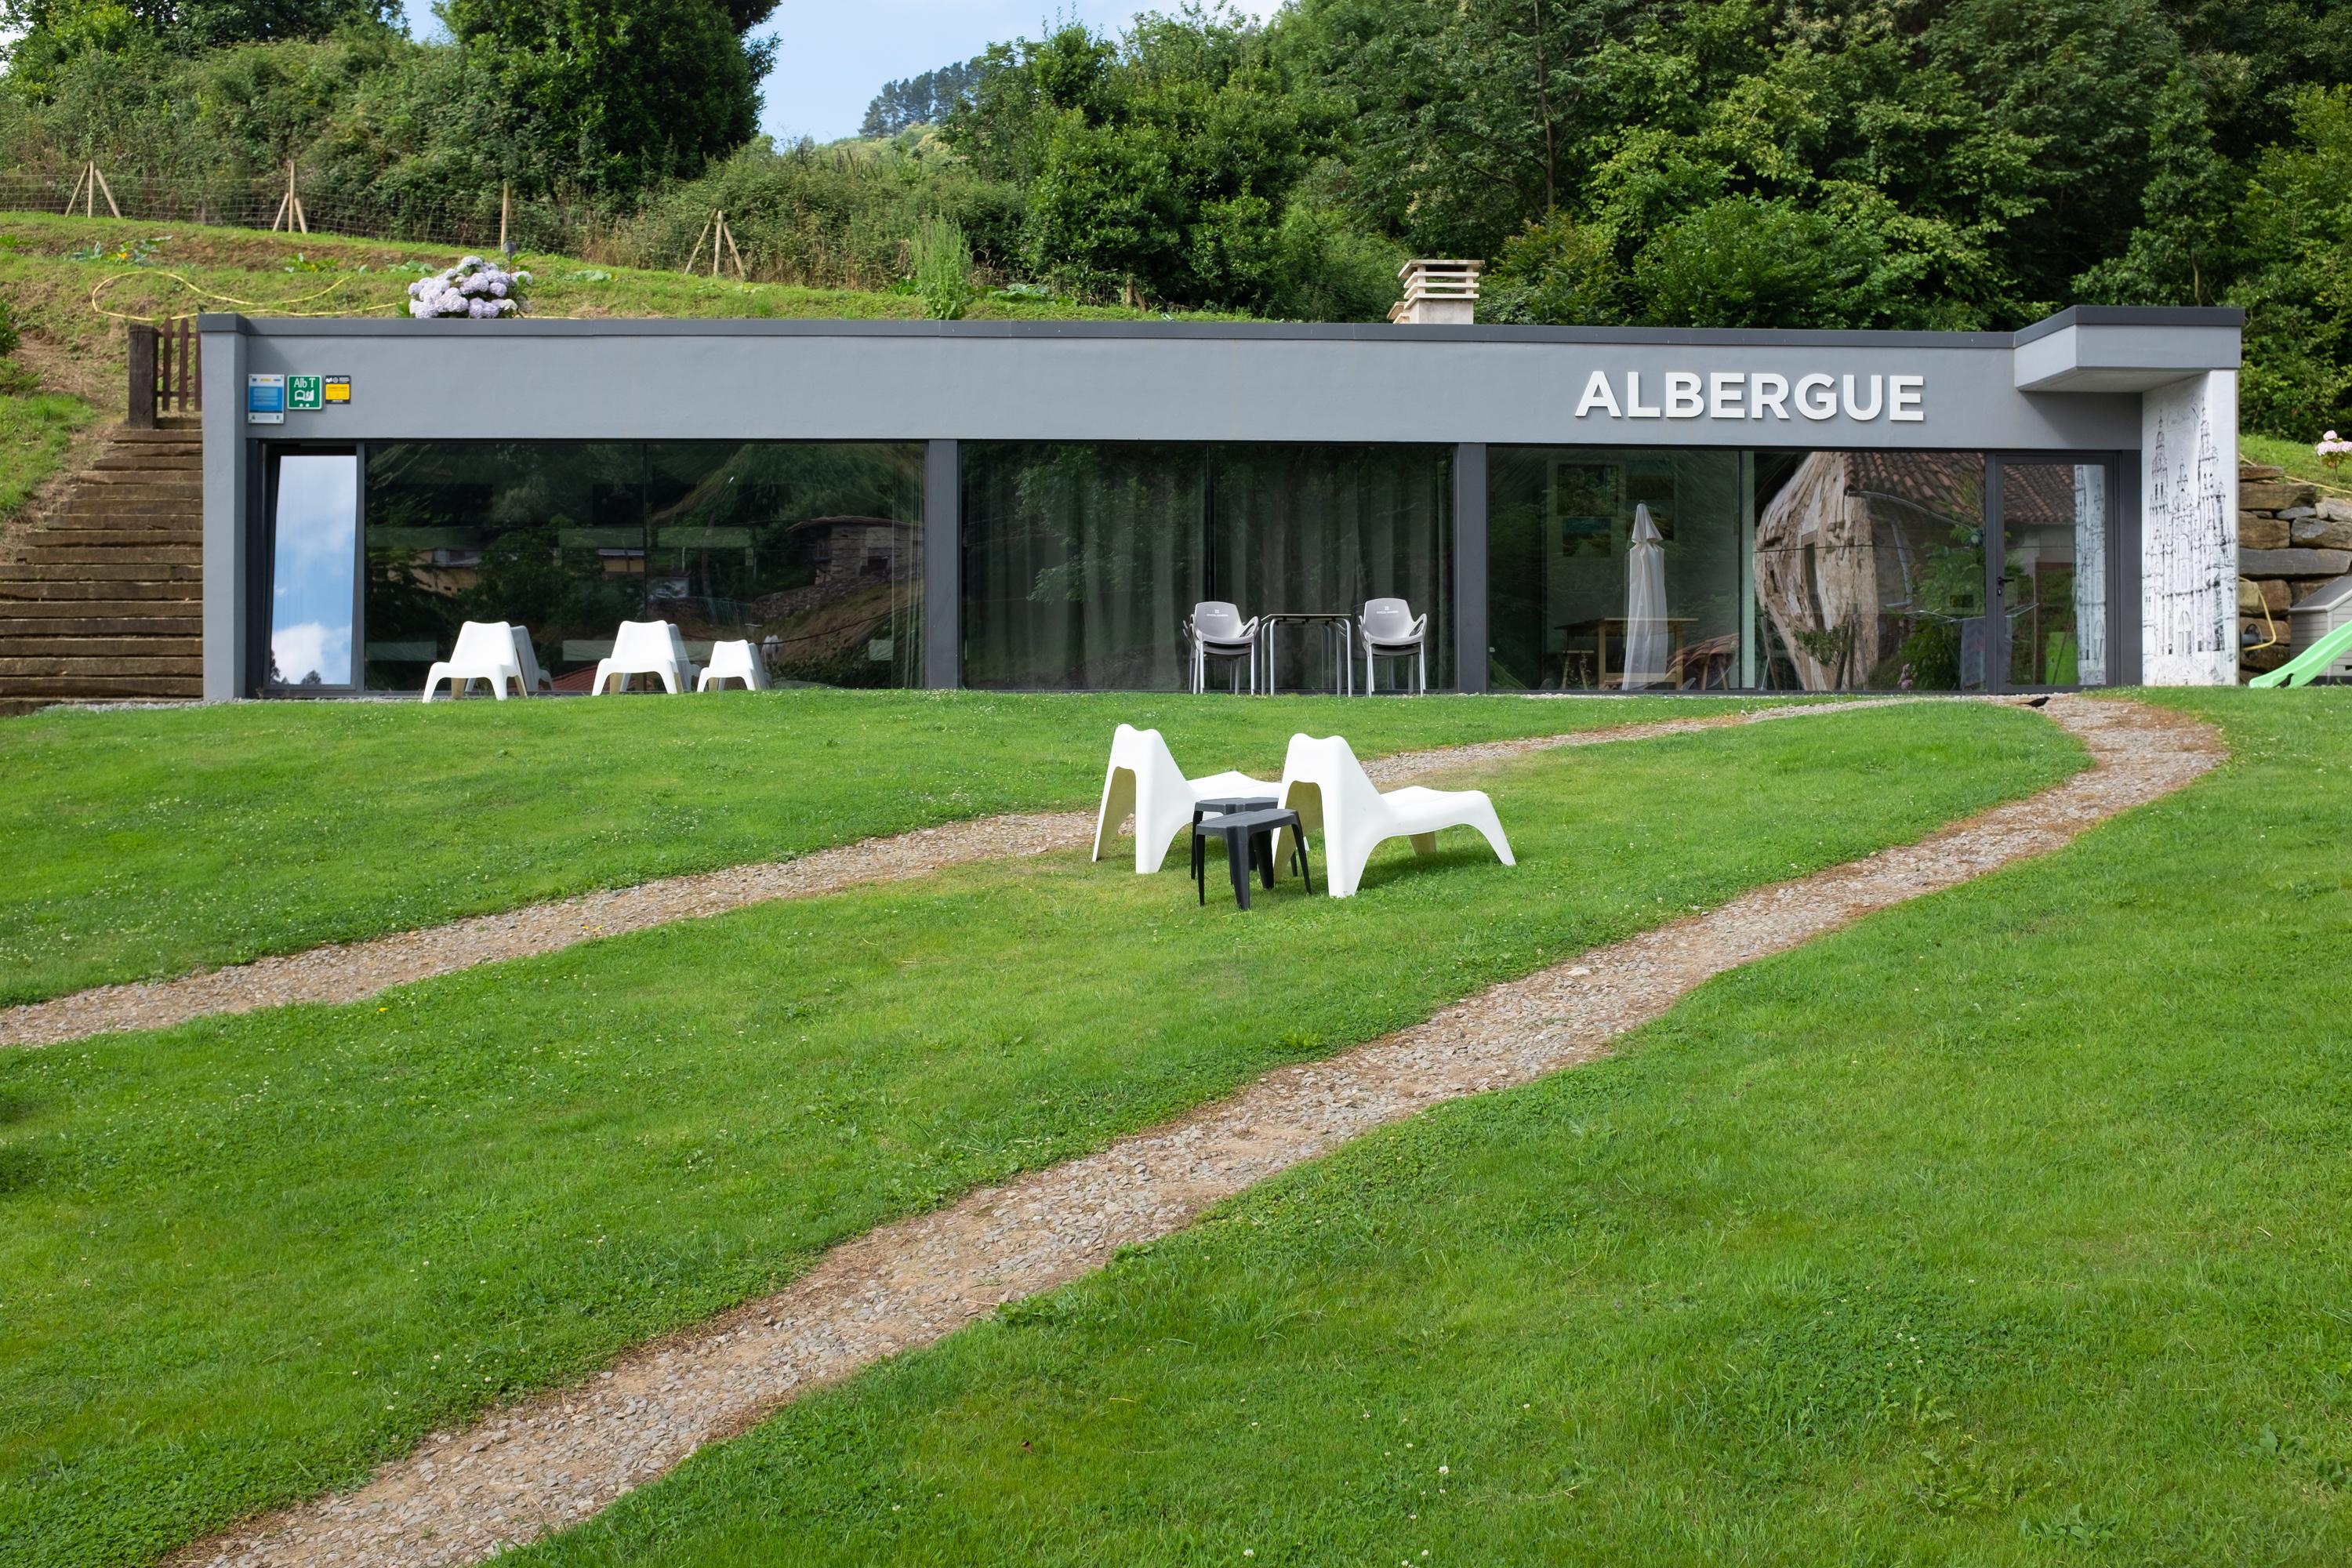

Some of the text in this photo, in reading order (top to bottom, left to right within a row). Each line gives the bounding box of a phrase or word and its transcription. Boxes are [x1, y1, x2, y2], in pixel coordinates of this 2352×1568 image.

[293, 377, 316, 388] Alb T
[1574, 370, 1925, 422] ALBERGUE
